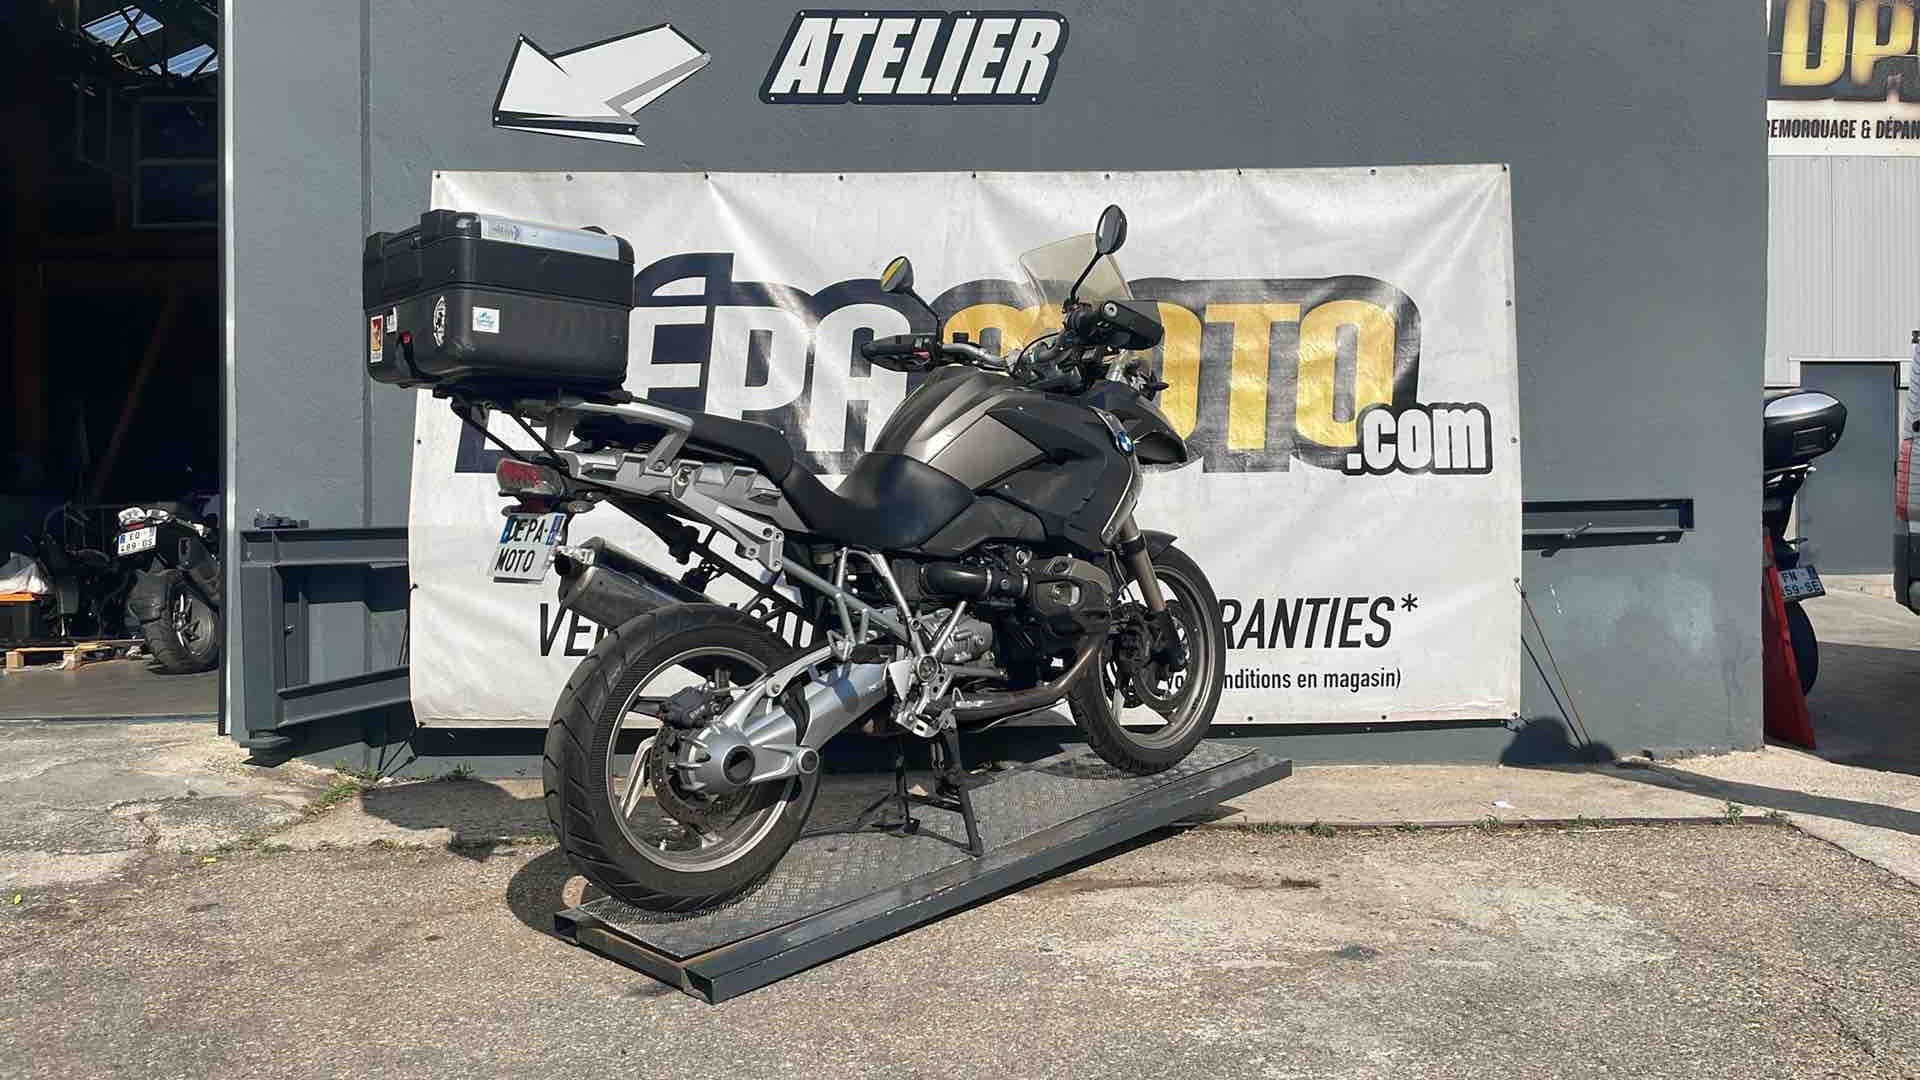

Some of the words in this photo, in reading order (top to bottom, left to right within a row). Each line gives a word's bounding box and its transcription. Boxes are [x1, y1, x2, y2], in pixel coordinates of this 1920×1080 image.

[768, 17, 1062, 95] ATELIER
[1861, 120, 1872, 139] &
[494, 548, 535, 573] MOTO
[1218, 594, 1418, 649] RANTIES
[1223, 668, 1291, 689] nditions
[1297, 674, 1318, 688] en
[1323, 667, 1402, 693] magasin)
